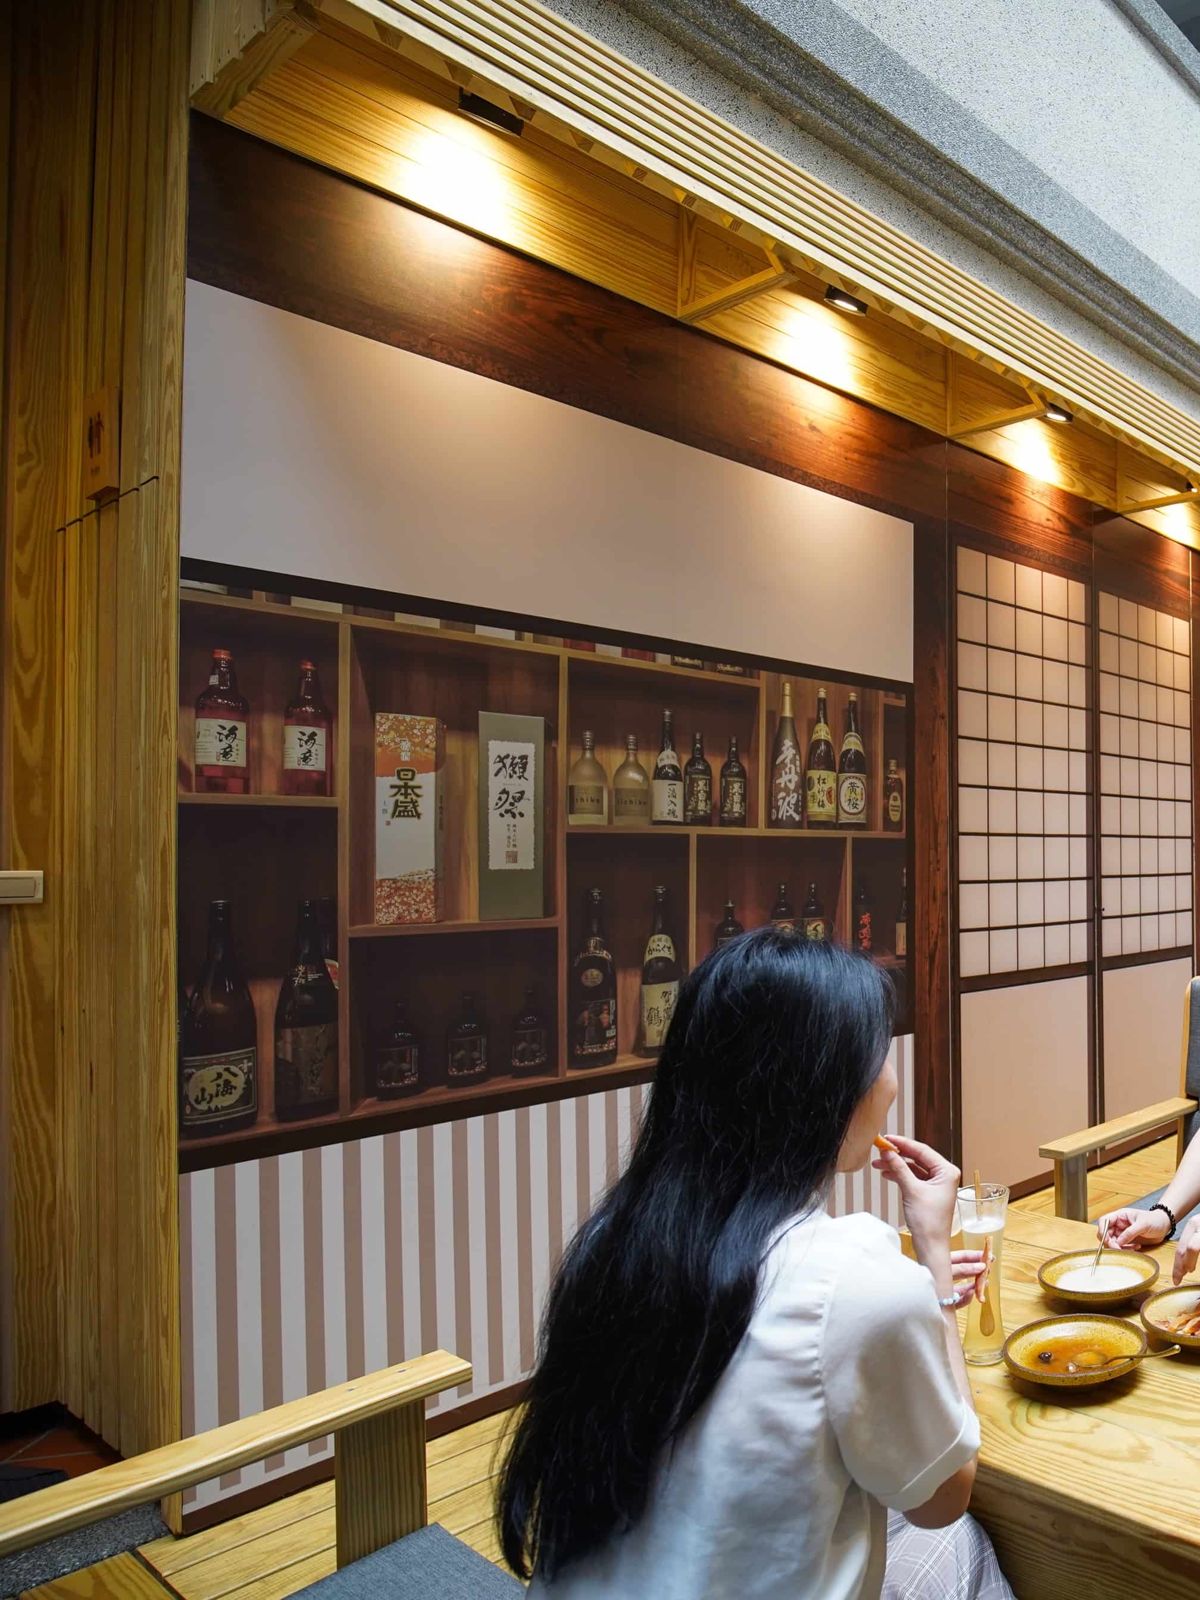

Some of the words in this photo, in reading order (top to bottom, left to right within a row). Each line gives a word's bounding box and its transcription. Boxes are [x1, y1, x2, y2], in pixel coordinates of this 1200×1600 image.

[389, 767, 424, 819] 日本盛
[493, 753, 529, 819] 獺祭
[776, 739, 799, 822] 辛丹波
[816, 774, 826, 809] 松竹梅
[847, 781, 859, 811] 黄桜
[194, 1066, 240, 1106] 八海山
